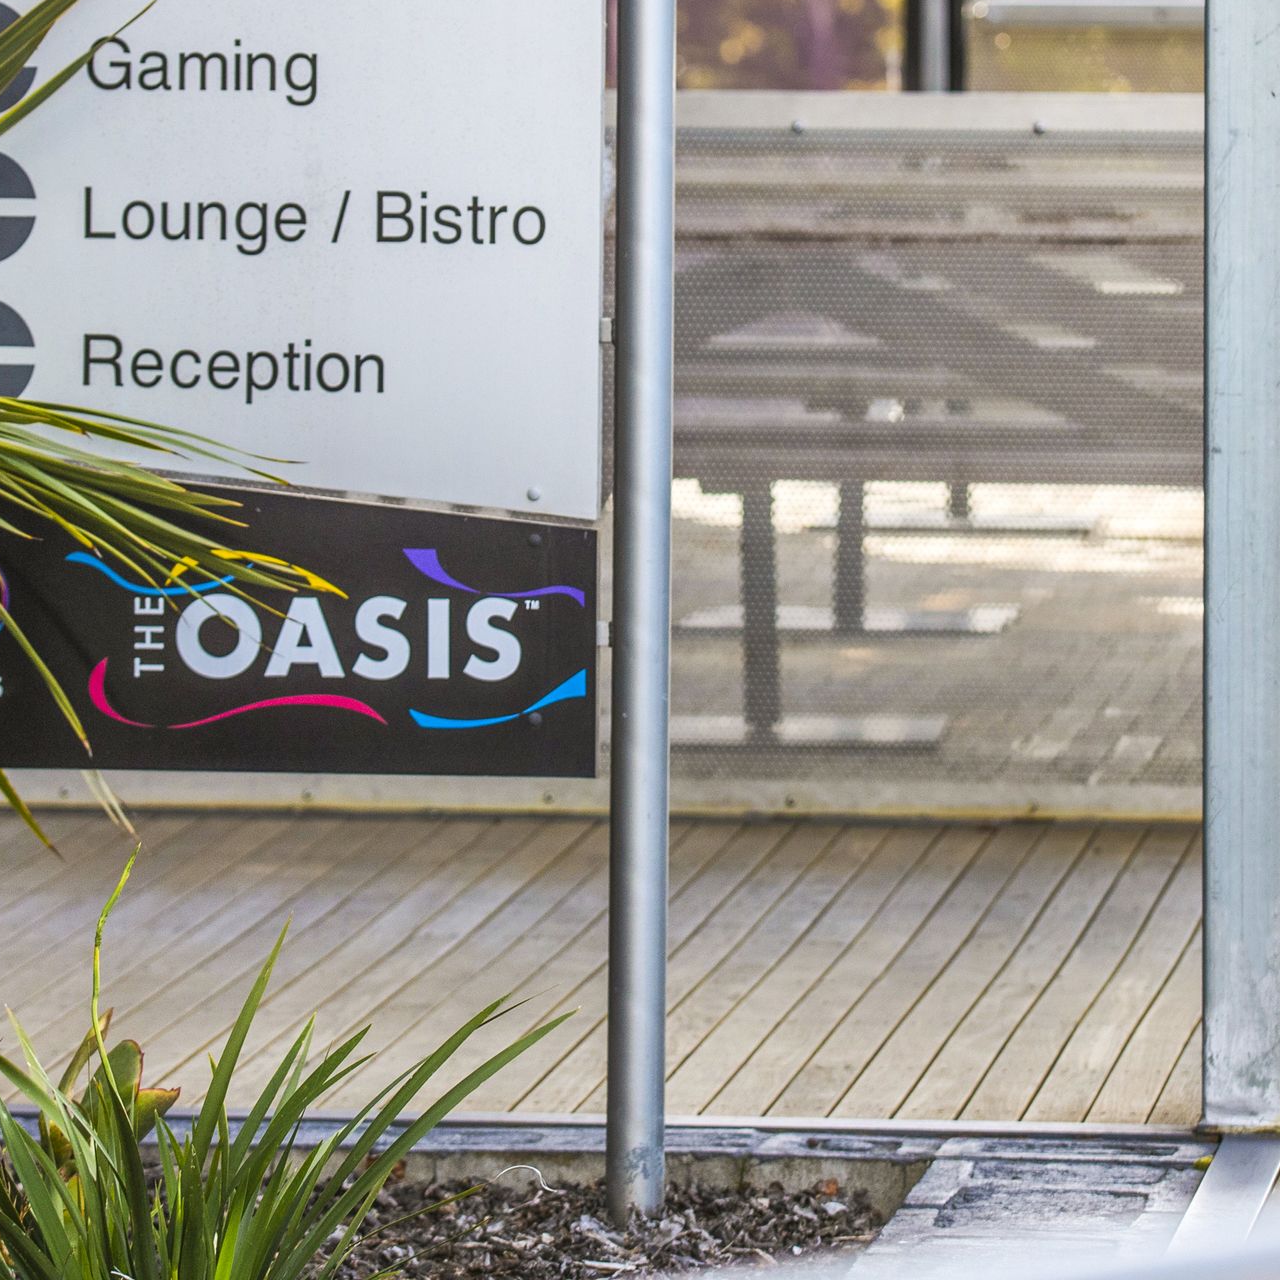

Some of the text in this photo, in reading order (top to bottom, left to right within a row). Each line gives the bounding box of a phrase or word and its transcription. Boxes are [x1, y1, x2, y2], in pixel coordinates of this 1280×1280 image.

[87, 36, 318, 107] Gaming
[84, 186, 308, 255] Lounge
[376, 190, 547, 246] Bistro
[82, 333, 386, 404] Reception
[133, 596, 166, 678] THE
[175, 593, 522, 682] OASIS
